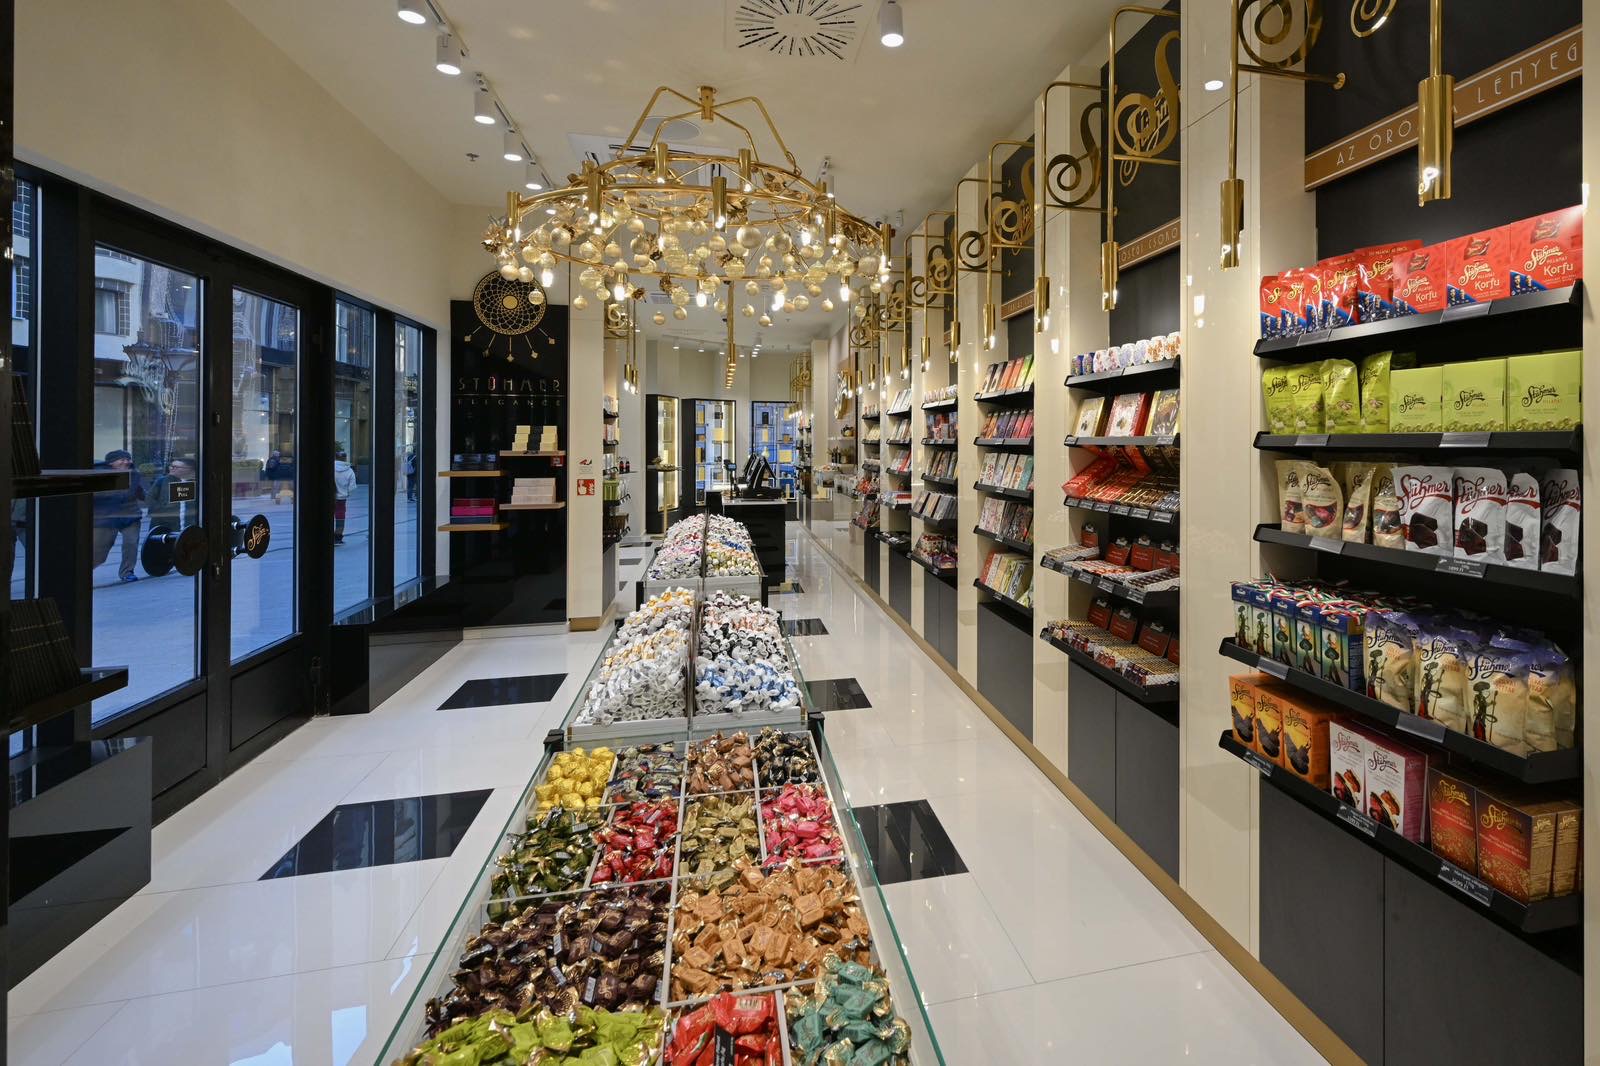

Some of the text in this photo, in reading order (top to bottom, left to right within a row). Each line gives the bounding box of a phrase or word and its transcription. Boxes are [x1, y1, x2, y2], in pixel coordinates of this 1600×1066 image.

[1336, 145, 1355, 166] AZ
[1543, 262, 1574, 277] Korfu
[1475, 278, 1501, 291] Korfu
